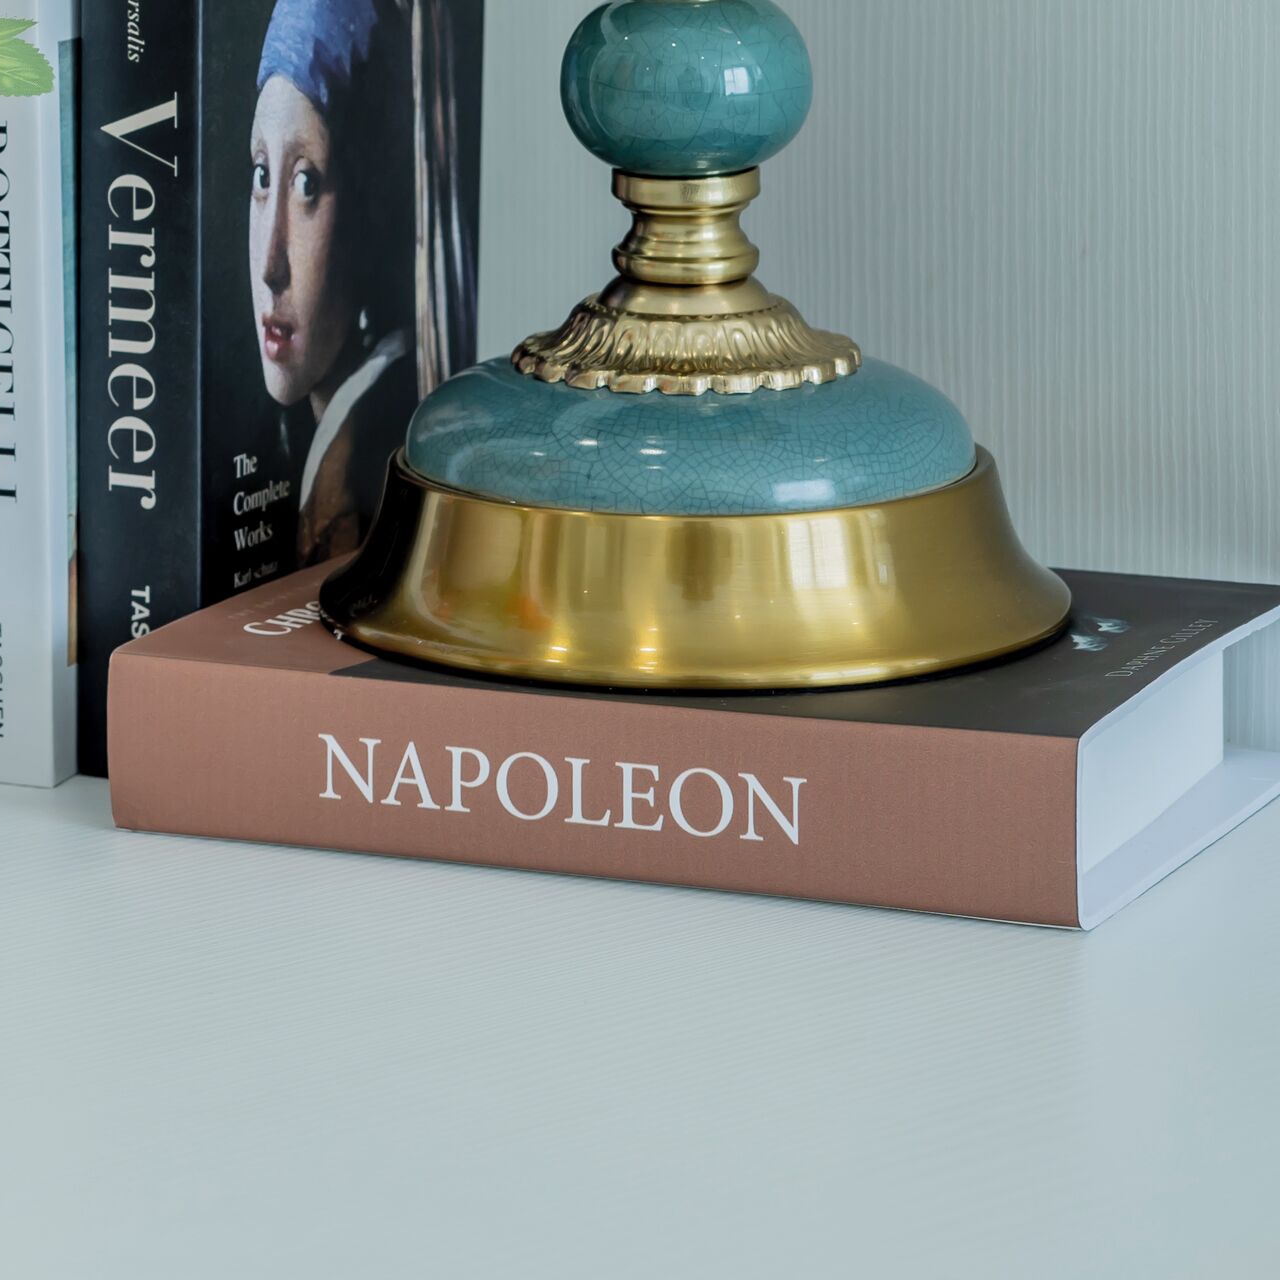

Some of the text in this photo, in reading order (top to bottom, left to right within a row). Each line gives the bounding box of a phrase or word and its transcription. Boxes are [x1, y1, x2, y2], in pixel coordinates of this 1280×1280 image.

[100, 91, 178, 510] Vermeer
[233, 453, 258, 478] The
[233, 480, 290, 515] Complete
[234, 520, 273, 551] Works
[131, 585, 151, 638] TAS
[318, 734, 807, 845] NAPOLEON
